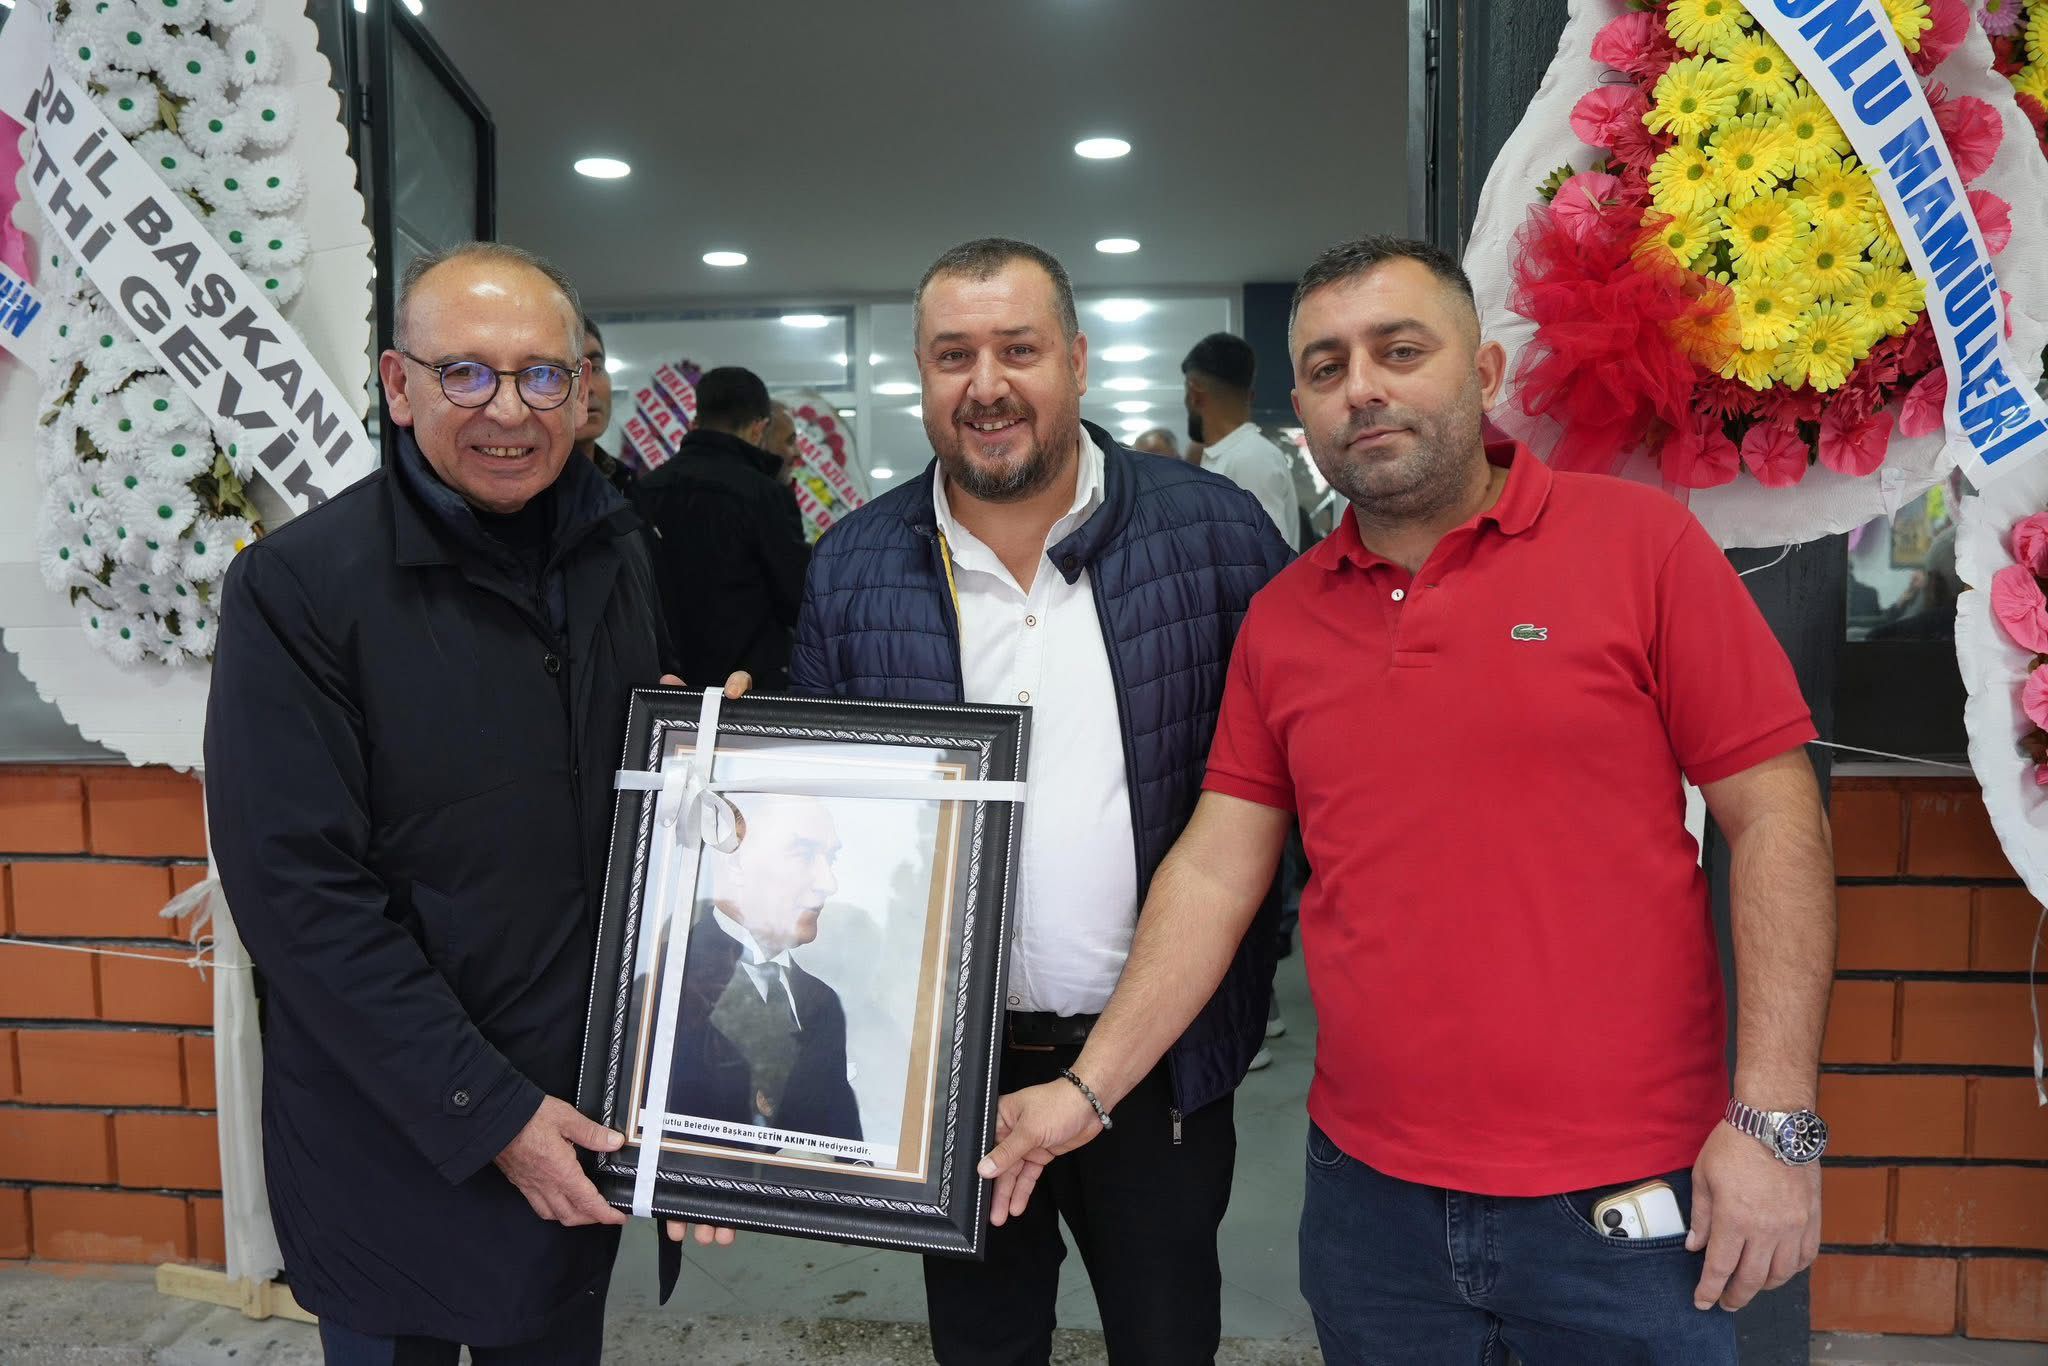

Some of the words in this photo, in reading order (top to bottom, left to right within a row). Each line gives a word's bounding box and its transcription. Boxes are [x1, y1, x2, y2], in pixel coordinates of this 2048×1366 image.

[73, 127, 118, 199] İL
[123, 197, 354, 468] BAŞKANI
[120, 275, 329, 511] GEVİK
[635, 387, 672, 430] ATA
[1879, 116, 2048, 465] MAMÜLLERİ
[684, 1120, 720, 1133] Belediye
[722, 1126, 755, 1138] Başkanı
[757, 1131, 783, 1142] ÇETİN
[818, 1140, 872, 1156] Hediyesidir.
